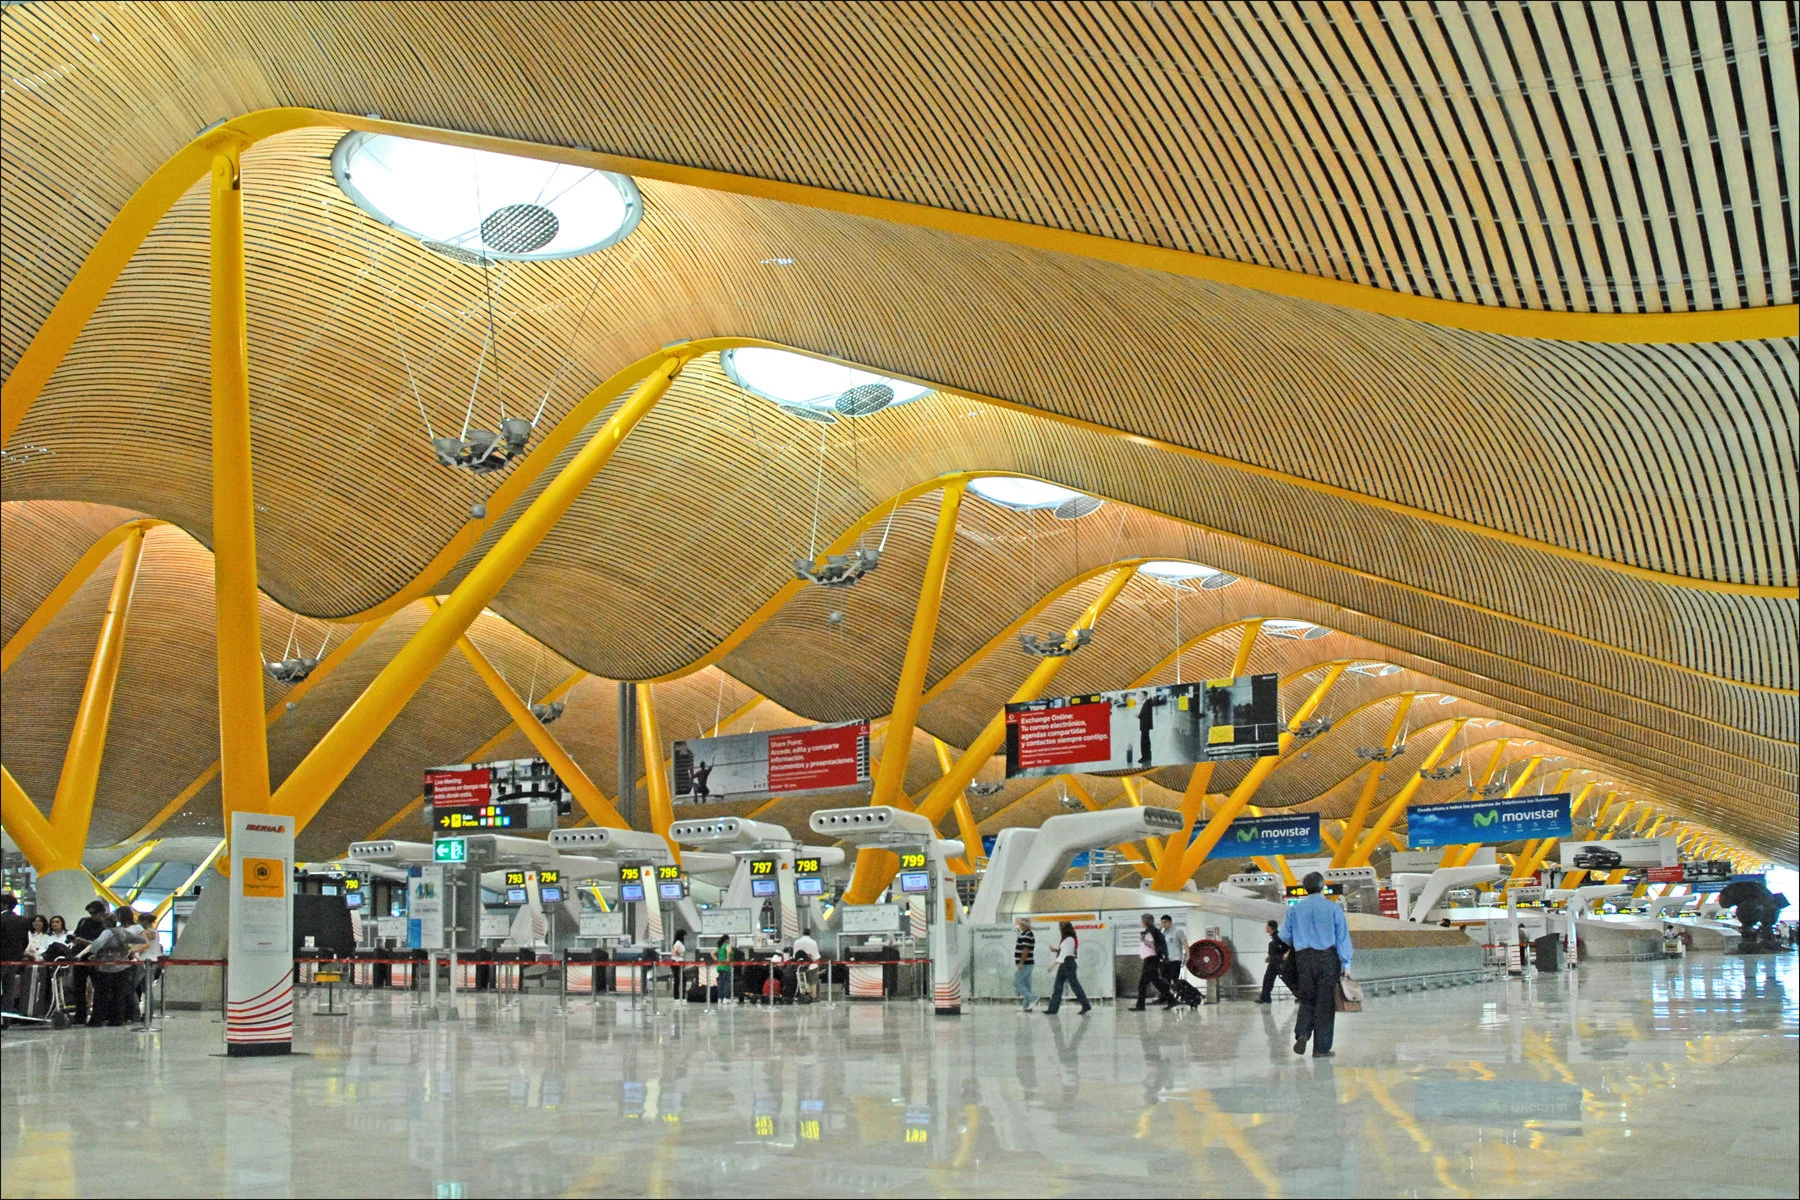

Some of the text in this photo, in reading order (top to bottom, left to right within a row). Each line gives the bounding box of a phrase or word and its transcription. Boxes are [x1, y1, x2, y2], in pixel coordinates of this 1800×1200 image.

[1021, 716, 1050, 725] Exchange
[1022, 728, 1086, 740] agendas compartidas
[1026, 738, 1056, 747] contactos
[1057, 735, 1082, 744] siempre
[812, 743, 839, 752] comparte
[1502, 809, 1559, 822] movistar
[246, 824, 279, 832] IBERIA
[1261, 827, 1310, 838] movistar
[797, 860, 818, 872] 798
[902, 854, 925, 867] 799
[621, 868, 638, 879] 795
[660, 867, 677, 878] 796
[753, 862, 772, 874] 797
[508, 874, 523, 884] 793
[541, 872, 557, 882] 794
[346, 880, 358, 889] 790
